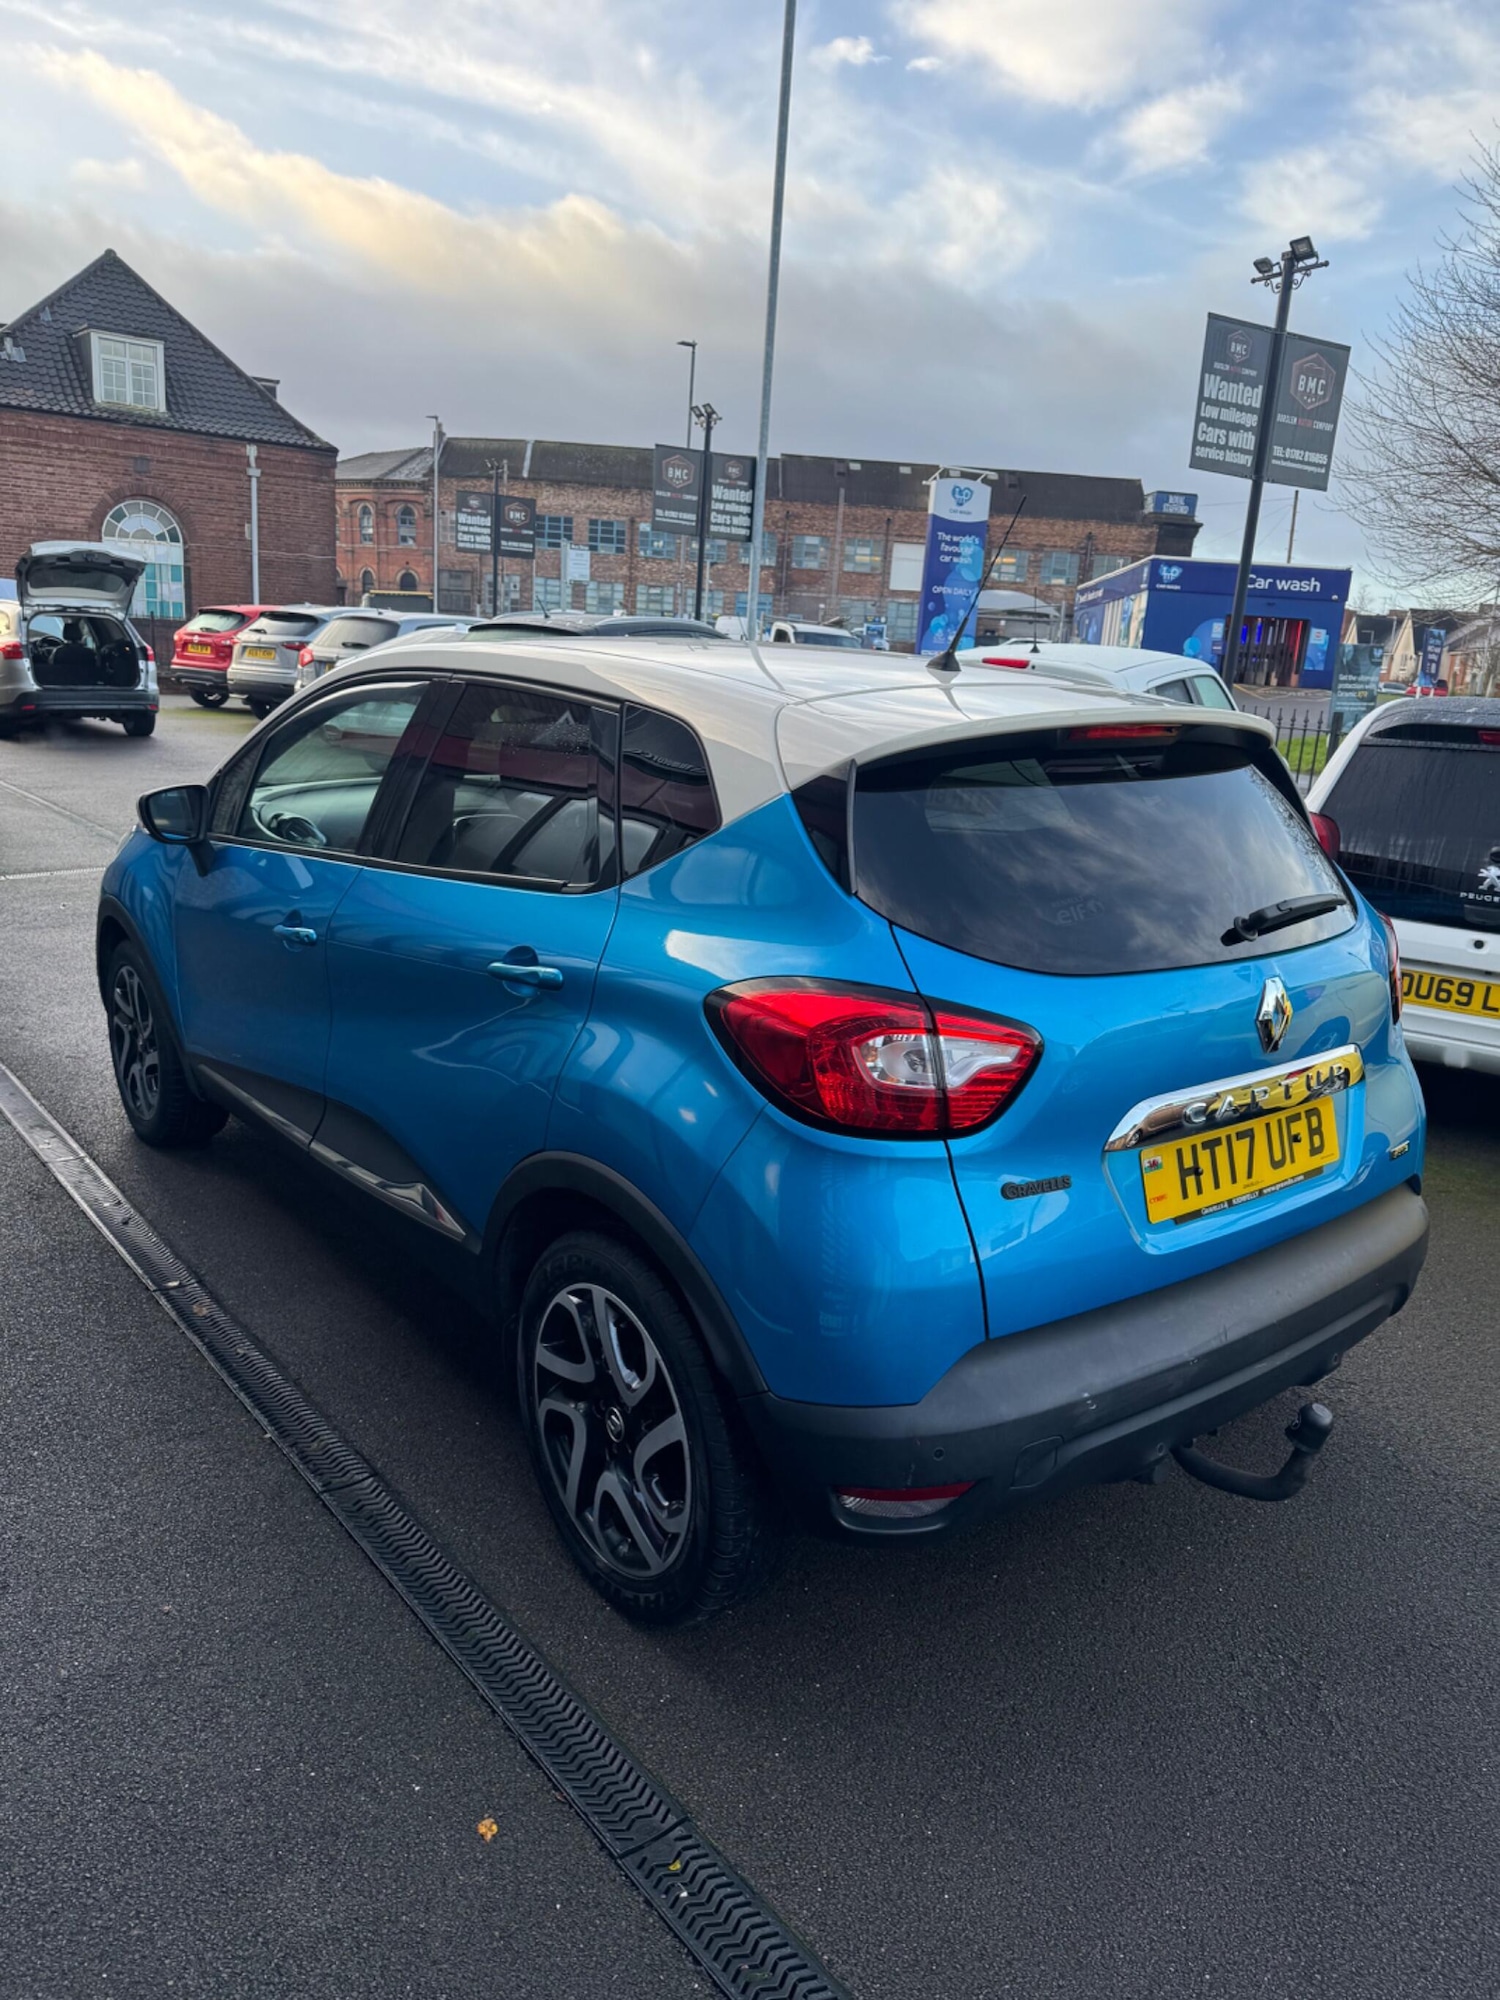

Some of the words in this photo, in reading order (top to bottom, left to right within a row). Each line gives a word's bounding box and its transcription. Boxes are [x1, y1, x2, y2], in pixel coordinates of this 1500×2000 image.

[1230, 341, 1247, 355] BMC
[1203, 373, 1263, 409] Wanted
[1298, 374, 1326, 396] BMC
[1200, 401, 1220, 420] Low
[1220, 407, 1259, 428] mileage
[1197, 421, 1227, 446] Cars
[1228, 430, 1256, 451] with
[1195, 445, 1225, 461] service
[1225, 448, 1253, 468] history
[667, 466, 689, 480] BMC
[712, 484, 753, 503] Wanted
[457, 512, 491, 527] Wanted
[710, 511, 731, 525] Cars
[937, 532, 952, 542] The
[952, 532, 980, 545] world's
[953, 555, 973, 565] wash
[932, 586, 952, 595] OPEN
[953, 587, 973, 597] DAILY
[1247, 573, 1274, 590] Car
[1276, 577, 1321, 593] wash
[1056, 903, 1086, 924] elf
[1402, 972, 1475, 1008] DU69
[1481, 985, 1500, 1013] L
[1183, 1063, 1347, 1127] CAPTUR
[1176, 1128, 1255, 1200] HT17
[1265, 1107, 1325, 1171] UFB
[1003, 1175, 1071, 1199] GRAVELLS
